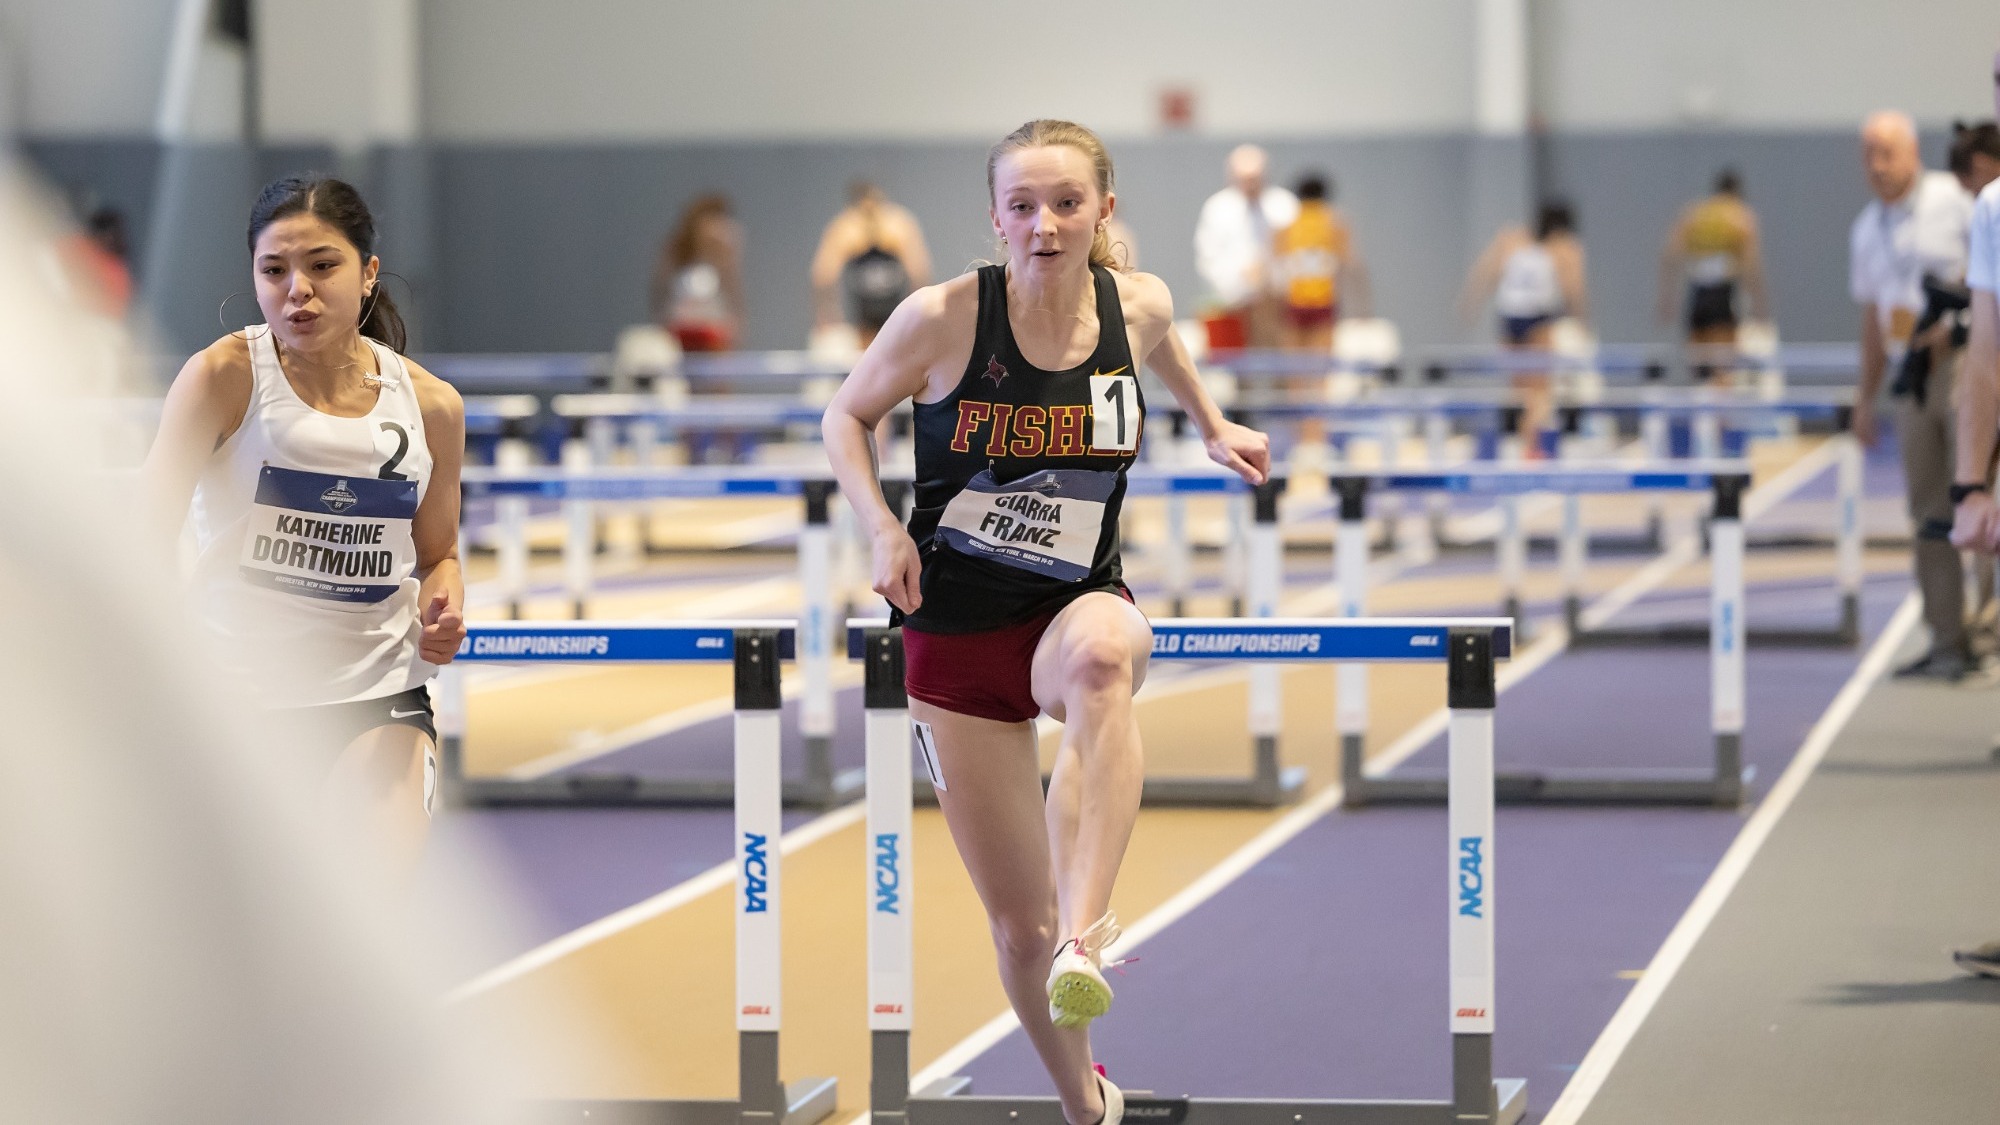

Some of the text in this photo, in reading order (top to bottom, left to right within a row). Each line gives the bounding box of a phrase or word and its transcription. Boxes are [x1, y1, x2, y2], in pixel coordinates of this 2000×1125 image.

[951, 400, 1143, 457] FISH
[1104, 380, 1126, 445] 1
[378, 421, 409, 481] 2
[252, 534, 392, 578] DORTMUND
[275, 514, 386, 545] KATHERINE
[979, 511, 1062, 549] FRANZ
[474, 636, 610, 656] CHAMPIONSHIPS
[1152, 634, 1181, 653] ELD
[1182, 634, 1321, 653] CHAMPIONSHIPS
[744, 832, 767, 913] NCAA
[875, 833, 899, 914] NCAA
[1459, 836, 1482, 918] NCAA
